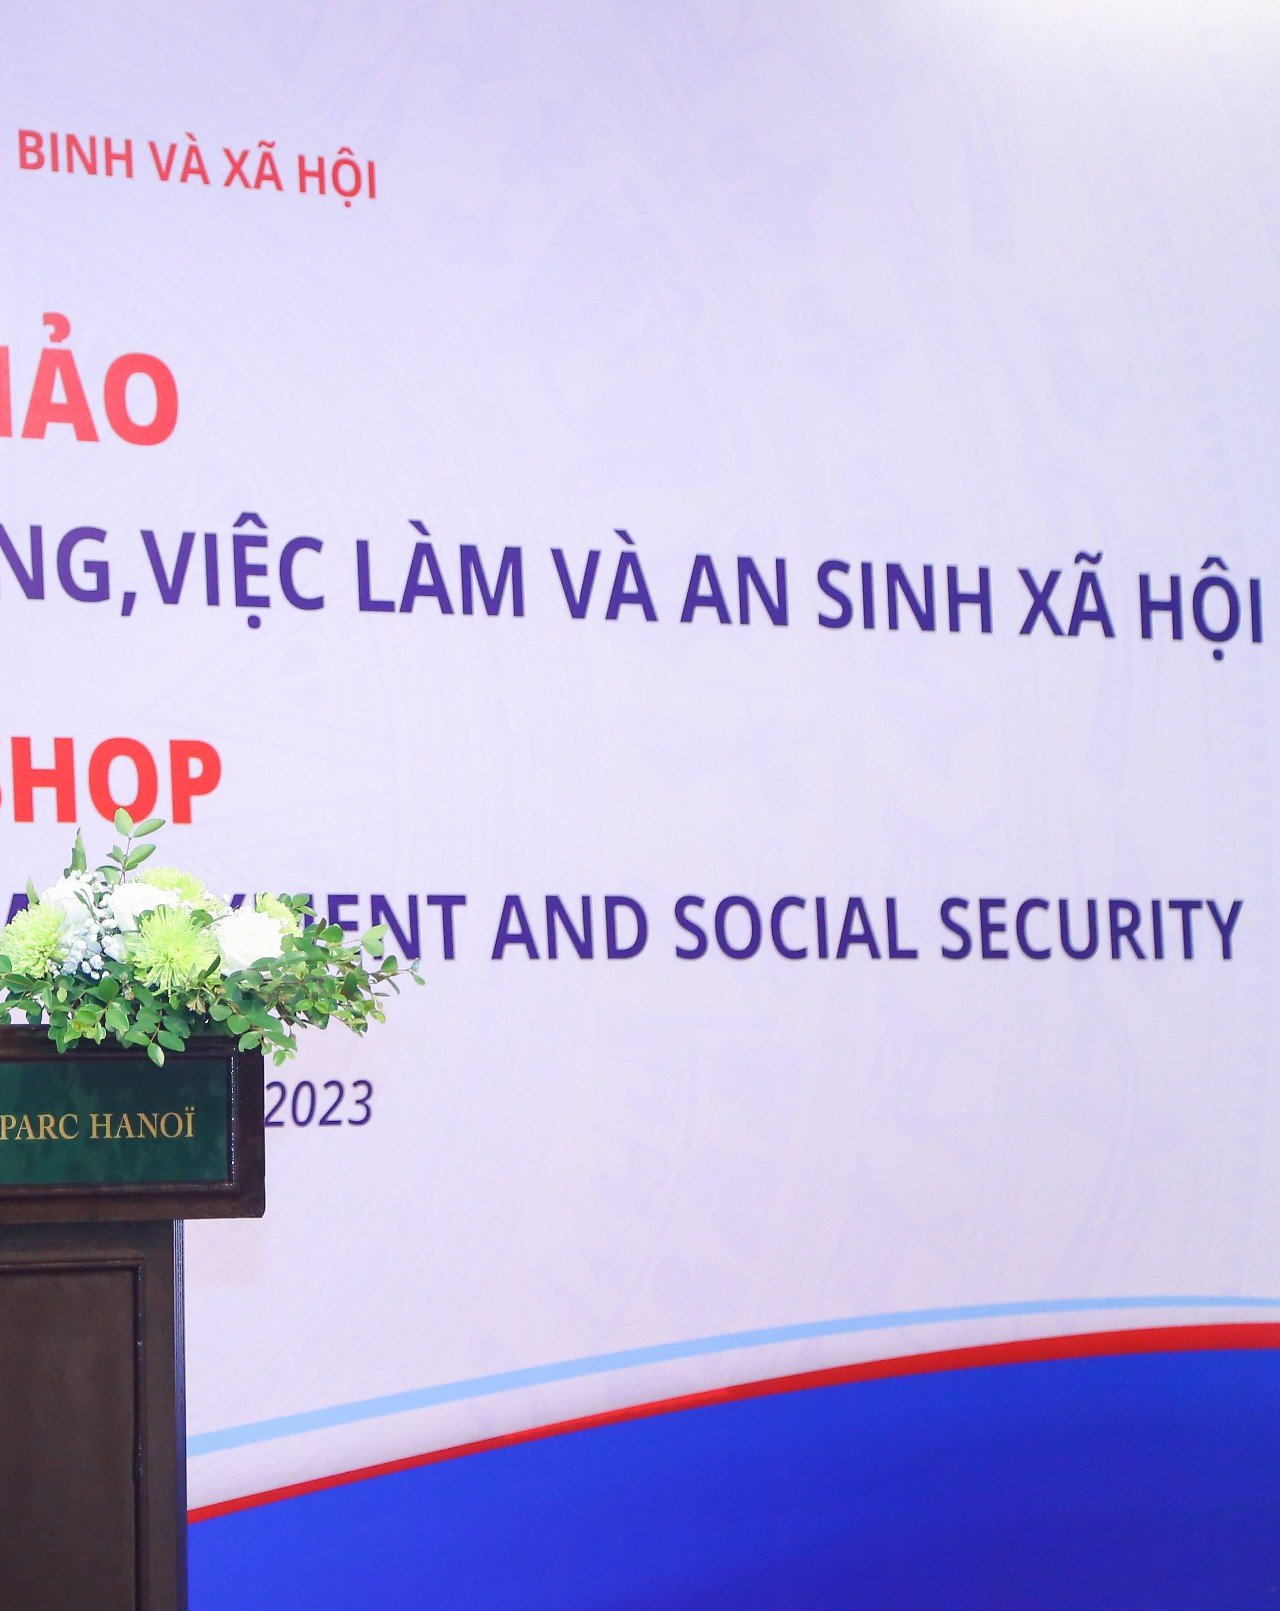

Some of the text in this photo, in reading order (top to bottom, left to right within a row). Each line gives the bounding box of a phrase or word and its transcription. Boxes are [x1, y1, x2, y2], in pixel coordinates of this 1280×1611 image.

[17, 129, 134, 179] BINH
[147, 132, 211, 185] VÀ
[223, 140, 284, 192] XÃ
[297, 146, 377, 208] HỘI
[355, 519, 526, 619] LÀM
[550, 528, 660, 623] VÀ
[679, 552, 790, 628] AN
[816, 559, 994, 635] SINH
[1018, 549, 1117, 640] XÃ
[1138, 555, 1264, 662] HỘI
[490, 893, 650, 961] AND
[673, 894, 920, 962] SOCIAL
[939, 895, 1245, 962] SECURITY
[89, 1106, 195, 1139] HANOÏ
[264, 1079, 374, 1128] 2023
